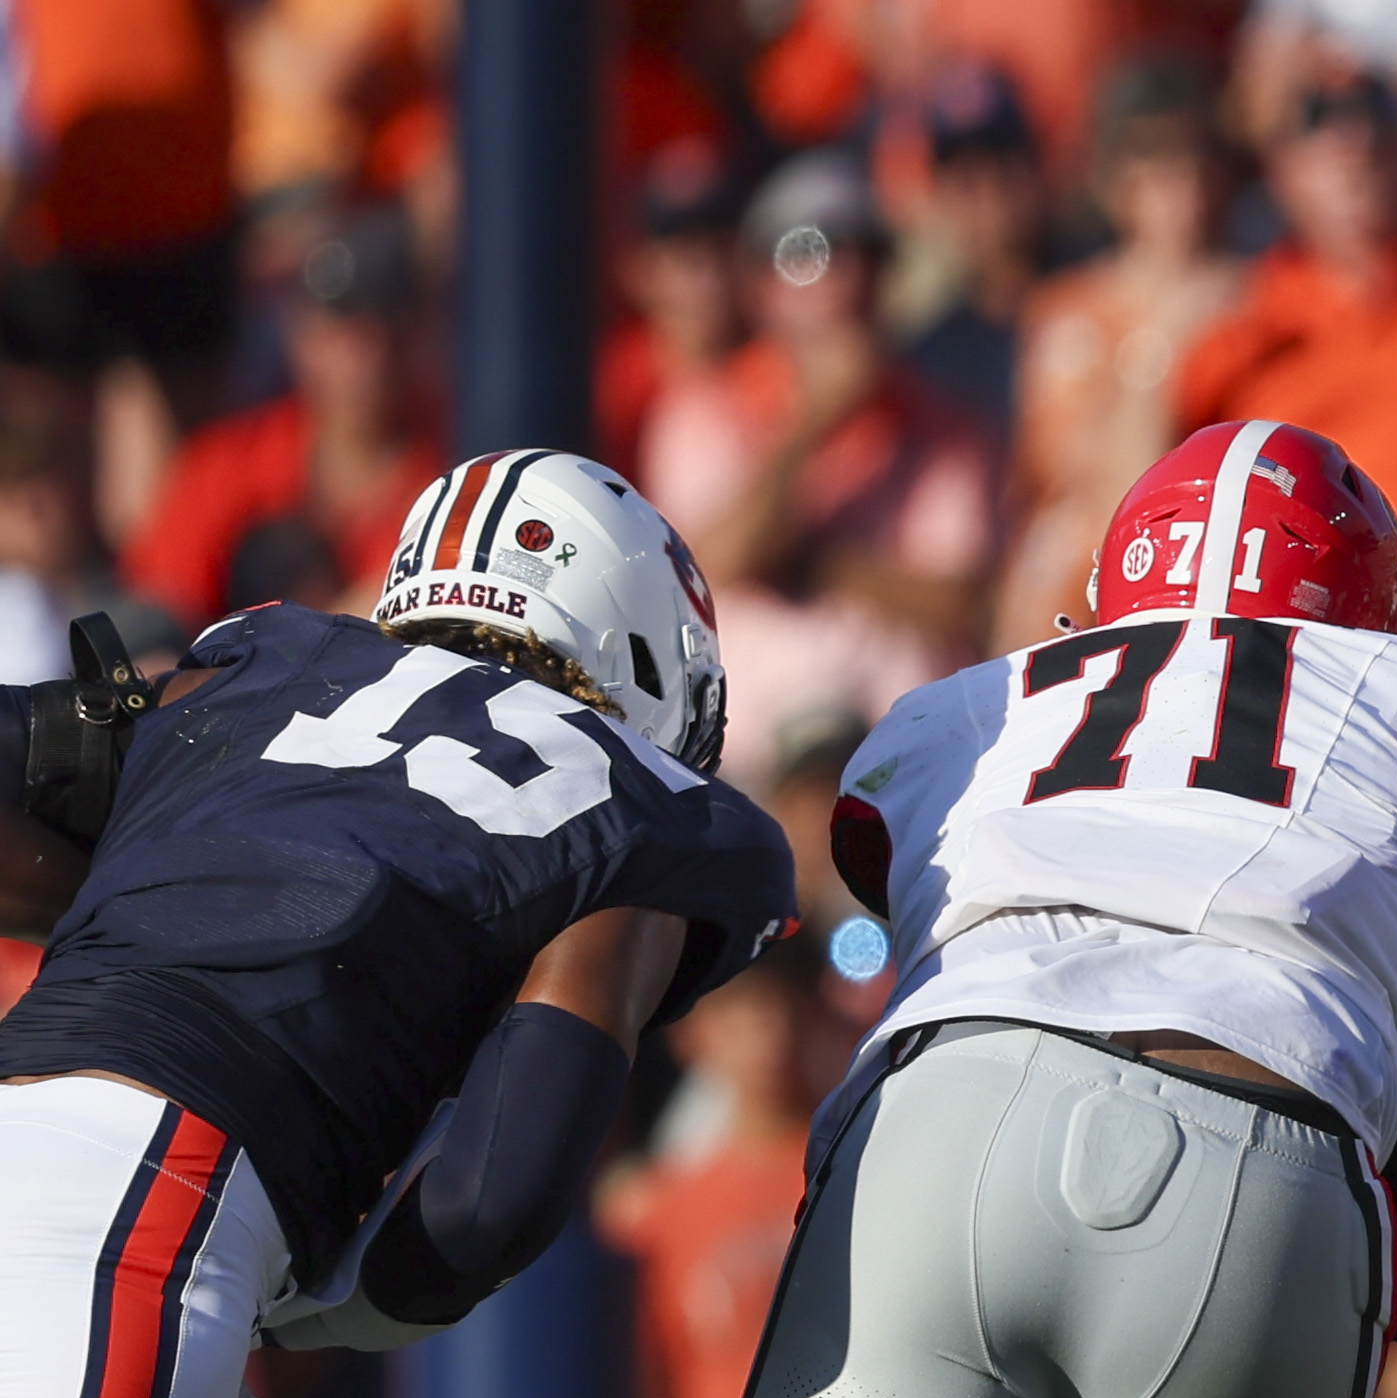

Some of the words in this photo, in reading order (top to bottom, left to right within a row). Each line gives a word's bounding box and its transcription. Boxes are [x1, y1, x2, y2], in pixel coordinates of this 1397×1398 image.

[1125, 540, 1151, 577] SEC
[426, 582, 528, 619] EAGLE
[1022, 617, 1303, 809] 71
